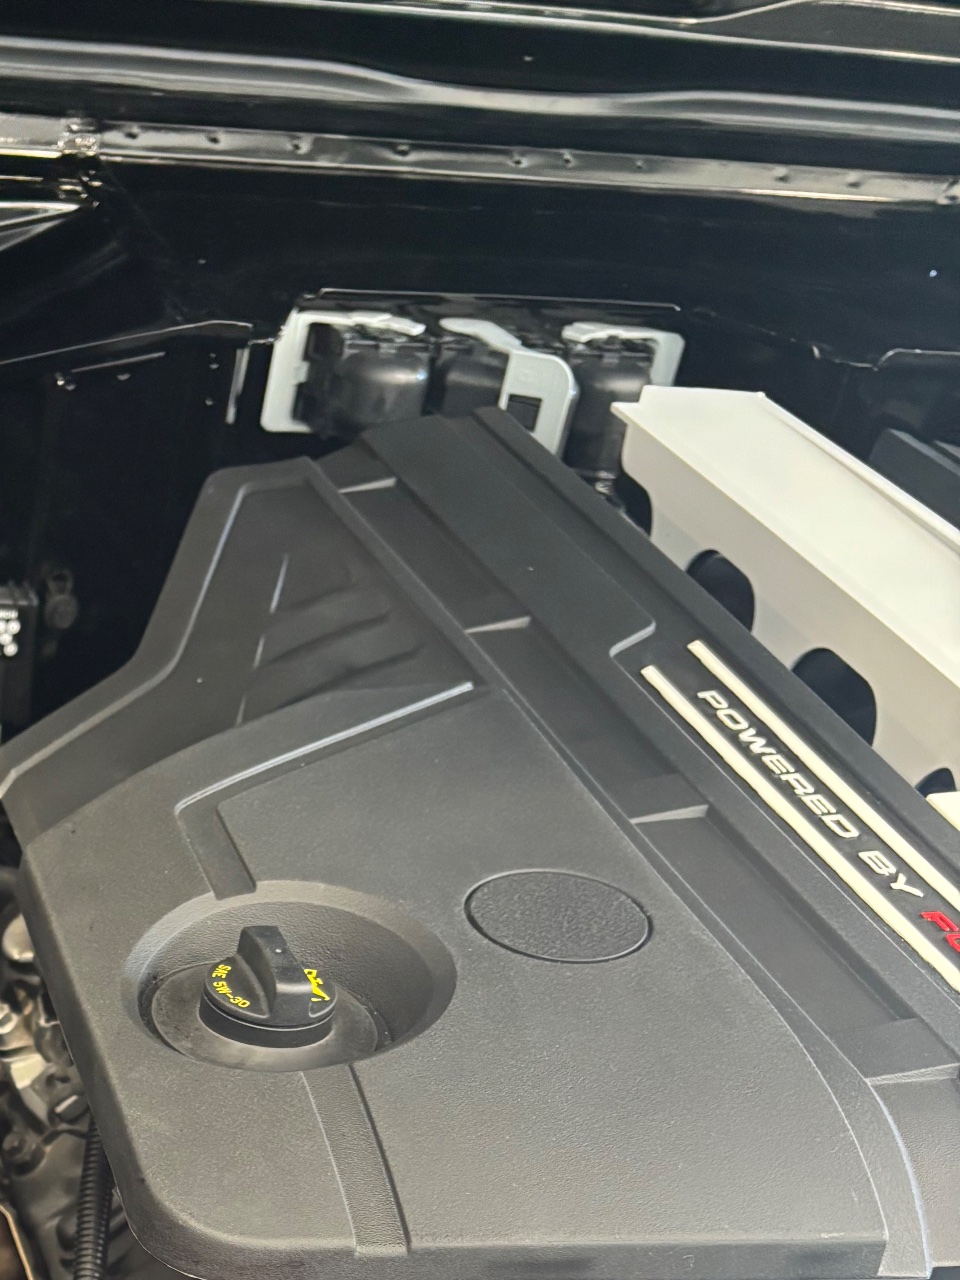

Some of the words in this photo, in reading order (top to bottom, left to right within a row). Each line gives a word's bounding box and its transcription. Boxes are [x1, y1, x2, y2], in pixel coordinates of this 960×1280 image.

[697, 690, 860, 839] POWERED
[858, 850, 924, 898] BY
[212, 964, 232, 979] SAE
[213, 981, 250, 1008] 5W-30
